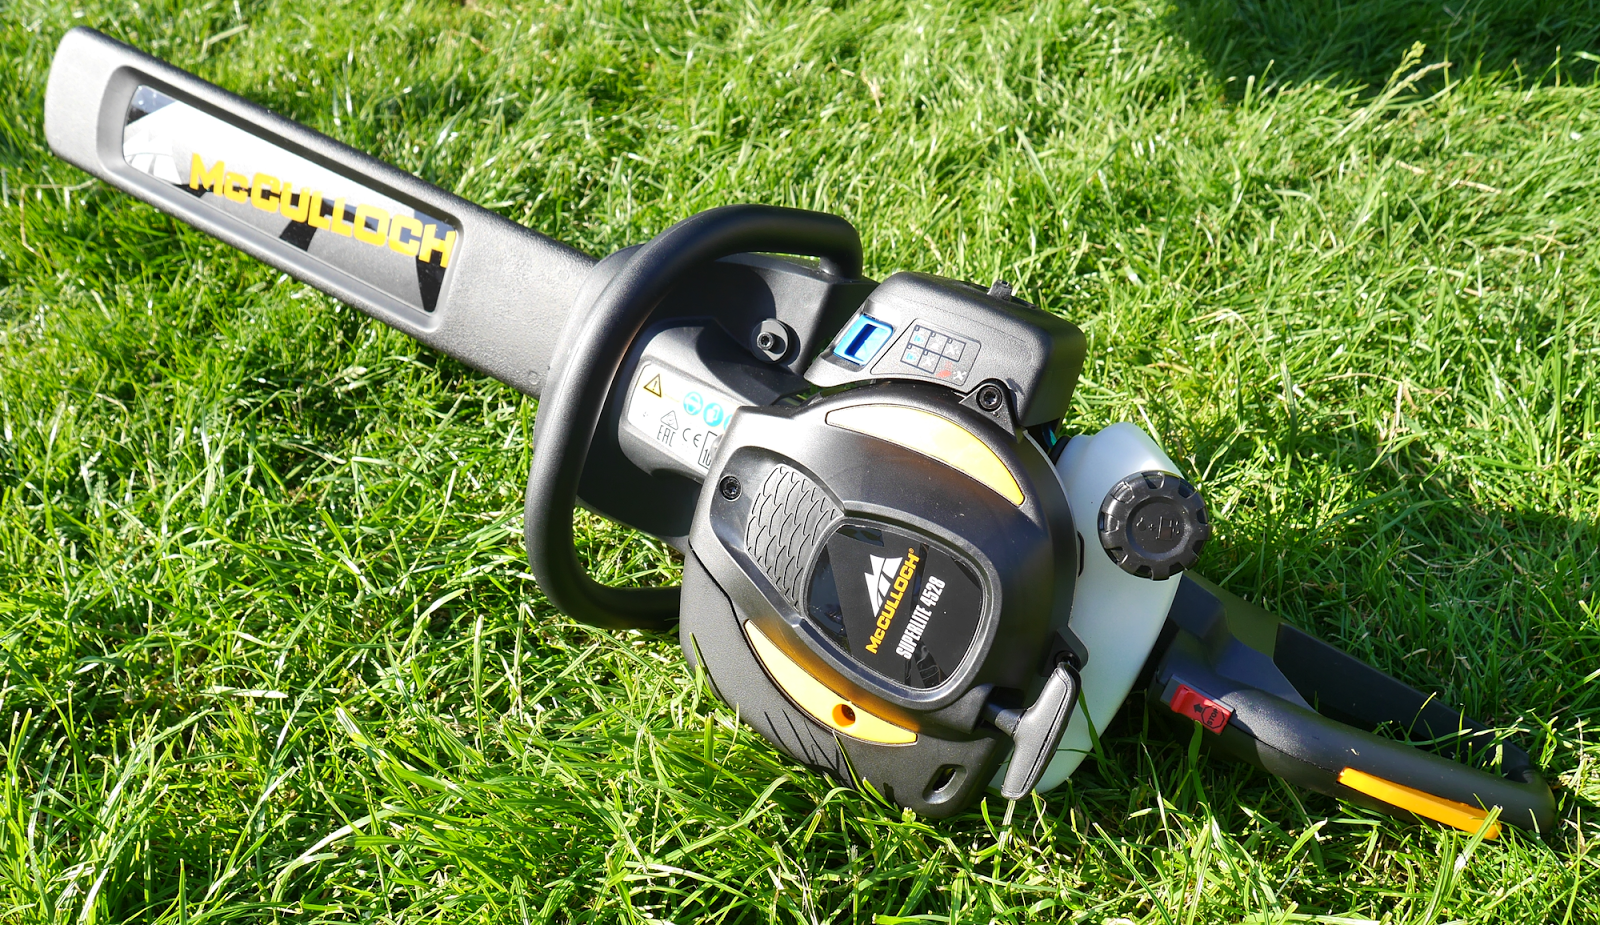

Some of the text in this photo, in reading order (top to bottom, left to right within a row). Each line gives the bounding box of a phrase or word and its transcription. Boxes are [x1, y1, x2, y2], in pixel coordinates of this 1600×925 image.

[189, 152, 456, 269] McCULLOCH
[895, 575, 946, 660] SUPERLITE 4528
[1206, 707, 1219, 726] STOP
